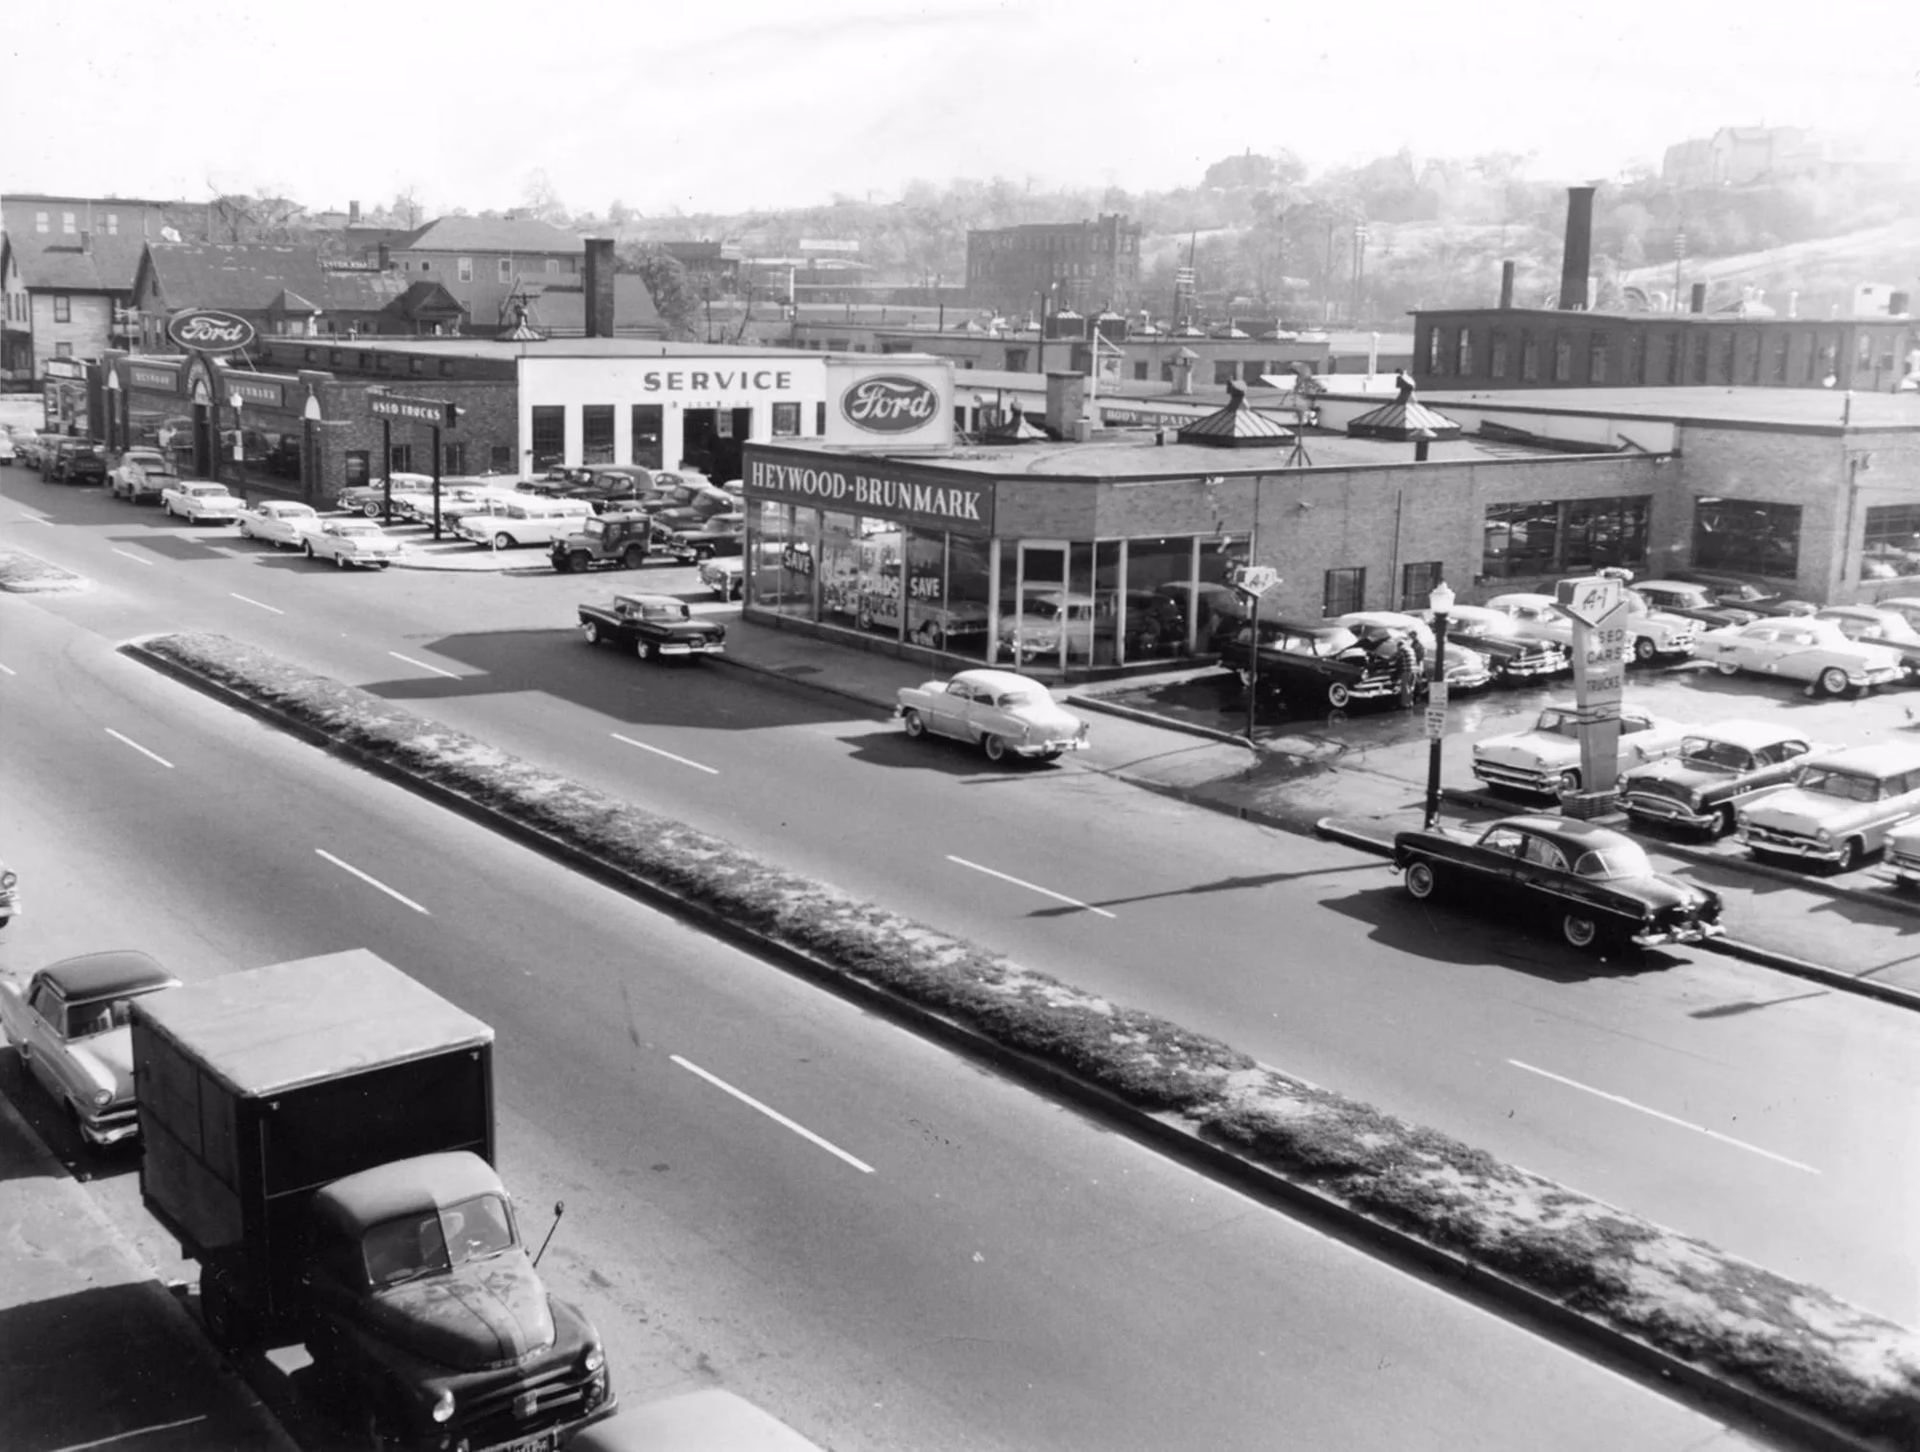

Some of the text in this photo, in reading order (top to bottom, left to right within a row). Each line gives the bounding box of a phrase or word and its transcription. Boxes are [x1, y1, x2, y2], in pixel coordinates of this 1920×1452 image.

[181, 316, 242, 340] Ford
[644, 371, 791, 391] SERVICE
[851, 381, 931, 419] Ford
[401, 404, 440, 420] TRUCKS
[783, 549, 811, 574] SAVE
[910, 576, 940, 598] SAVE
[1586, 647, 1622, 665] CARS
[1586, 676, 1620, 692] TRUCKS
